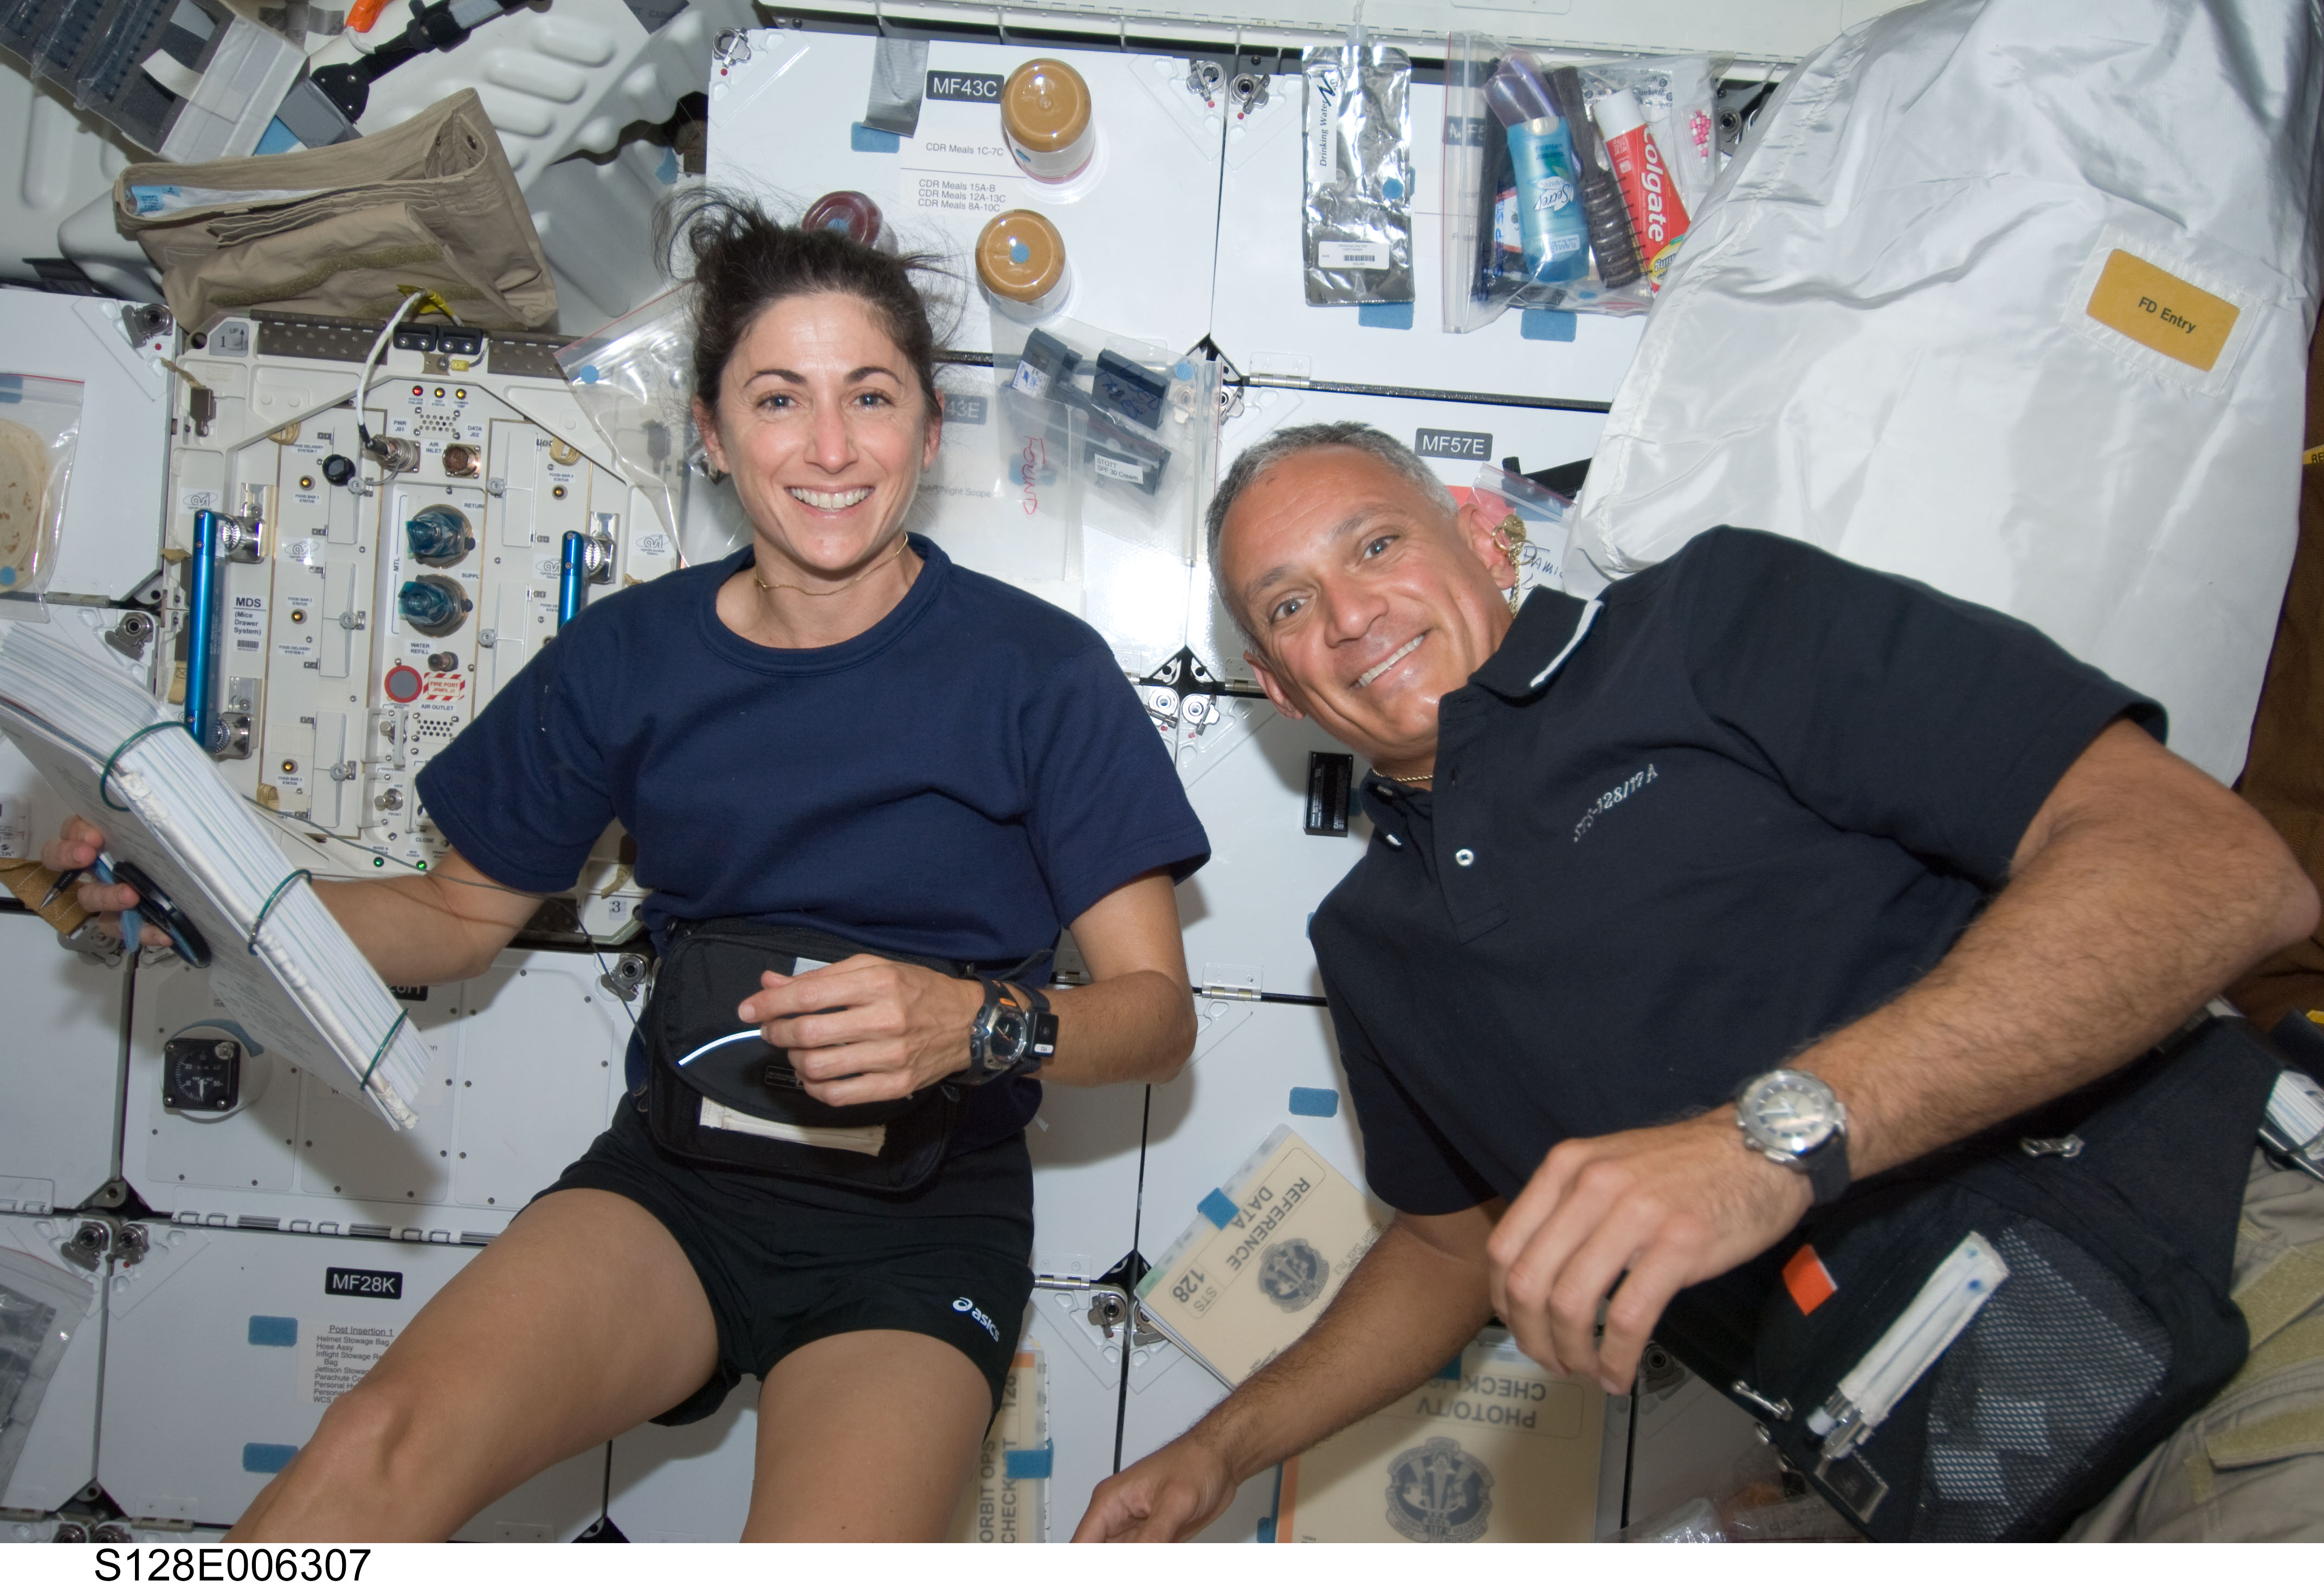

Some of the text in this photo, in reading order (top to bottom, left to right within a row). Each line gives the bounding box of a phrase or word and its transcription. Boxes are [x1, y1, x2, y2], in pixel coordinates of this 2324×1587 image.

[933, 77, 997, 97] MF43C
[1319, 98, 1329, 167] Drinking Water
[1449, 124, 1486, 141] MF5
[926, 142, 1004, 156] CDR Meals 1C-7C
[919, 179, 995, 192] CDR Meals 15A-B
[1641, 126, 1666, 242] Colgate
[919, 189, 1006, 203] CDR Meals 12A-13C
[1539, 184, 1571, 212] Secret
[918, 198, 1000, 212] CDR Meals 8A-10C
[2138, 295, 2196, 334] FD Entry
[221, 335, 226, 348] 1
[948, 402, 980, 418] 43E
[1423, 435, 1485, 455] MF57E
[1097, 458, 1117, 469] STOTT
[1098, 465, 1109, 474] SPF
[1118, 471, 1138, 481] Cream
[965, 488, 992, 498] Scope
[236, 597, 261, 608] MDS
[234, 627, 262, 636] System)
[612, 901, 621, 913] 3
[1230, 1186, 1274, 1229] DATA
[1225, 1176, 1311, 1271] REFERENCE
[333, 1274, 395, 1293] MF28K
[1172, 1267, 1206, 1304] 128
[1193, 1285, 1218, 1312] STS
[330, 1325, 348, 1333] Post
[351, 1326, 386, 1335] Insertion
[972, 1307, 999, 1342] asics
[344, 1336, 373, 1345] Stowage
[376, 1339, 390, 1347] Bag
[341, 1351, 371, 1361] Stowage
[314, 1381, 345, 1389] Personal
[315, 1373, 350, 1381] Parachute
[1416, 1396, 1538, 1429] PHOTO/TV
[979, 1439, 995, 1543] ORBIT OPS
